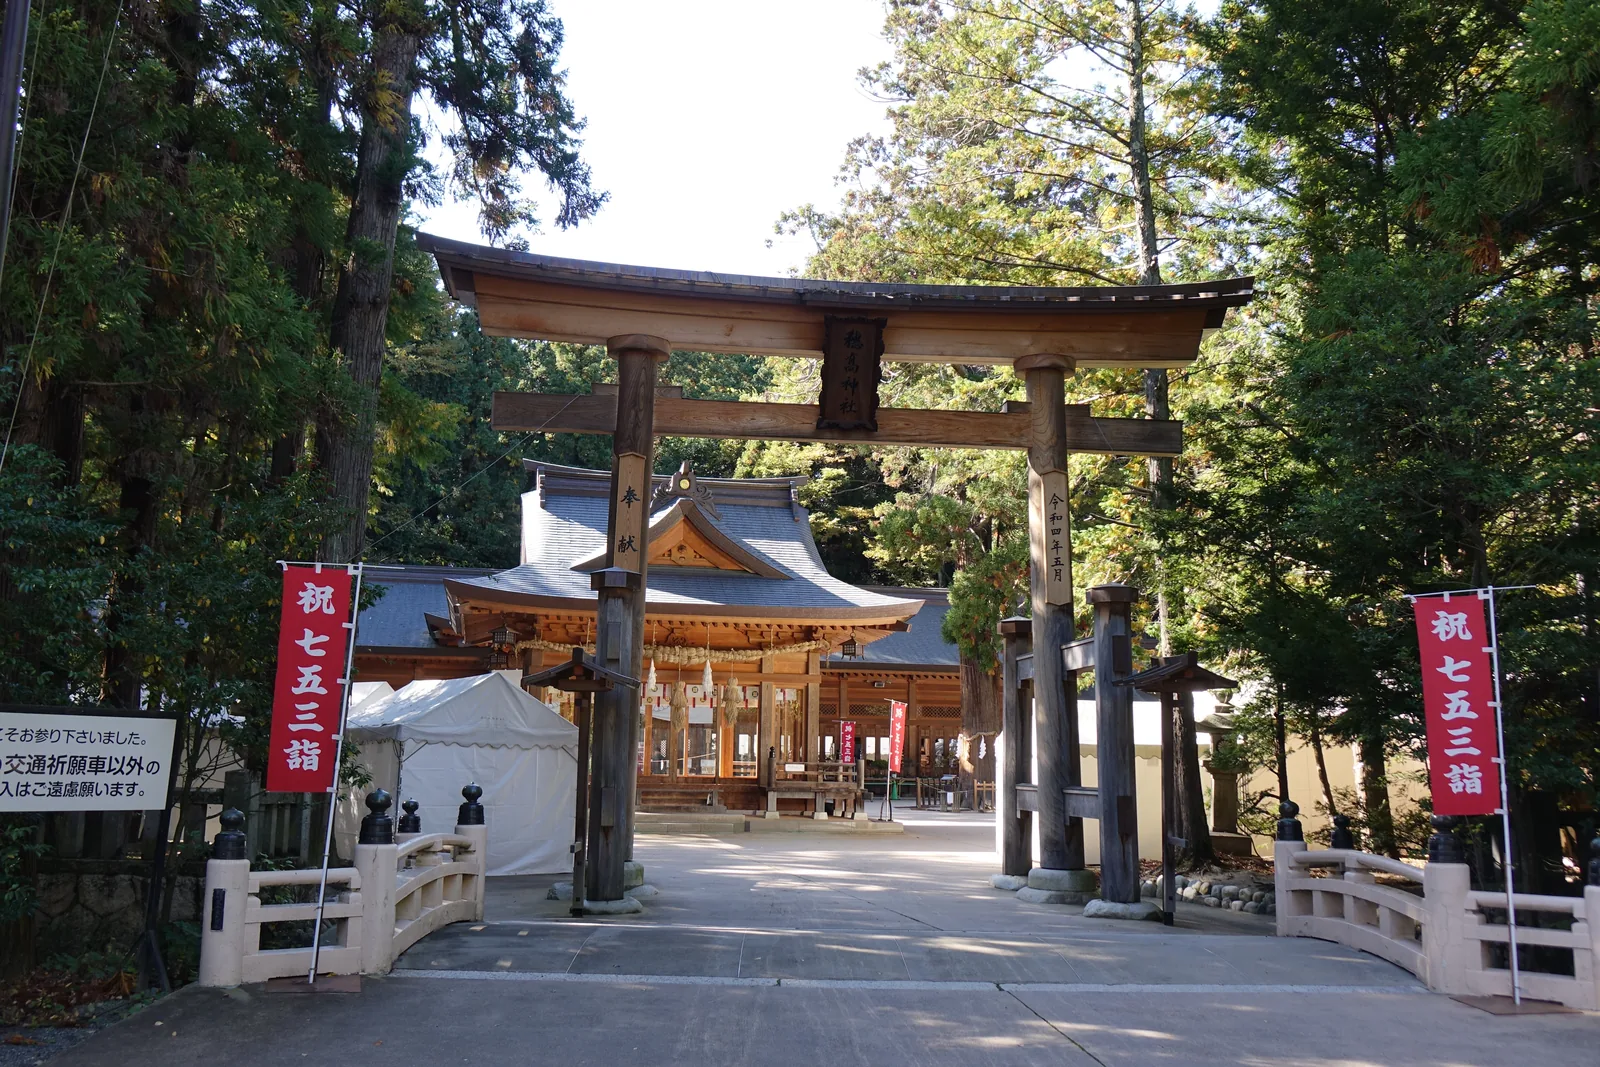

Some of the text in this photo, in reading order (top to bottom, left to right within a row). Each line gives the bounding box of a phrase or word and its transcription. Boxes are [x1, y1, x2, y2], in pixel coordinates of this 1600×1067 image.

[617, 485, 641, 553] 奉献
[1048, 493, 1065, 582] 令和四年五月
[0, 728, 146, 746] そお参り下さいました。
[0, 753, 160, 776] 交通祈願車以外の
